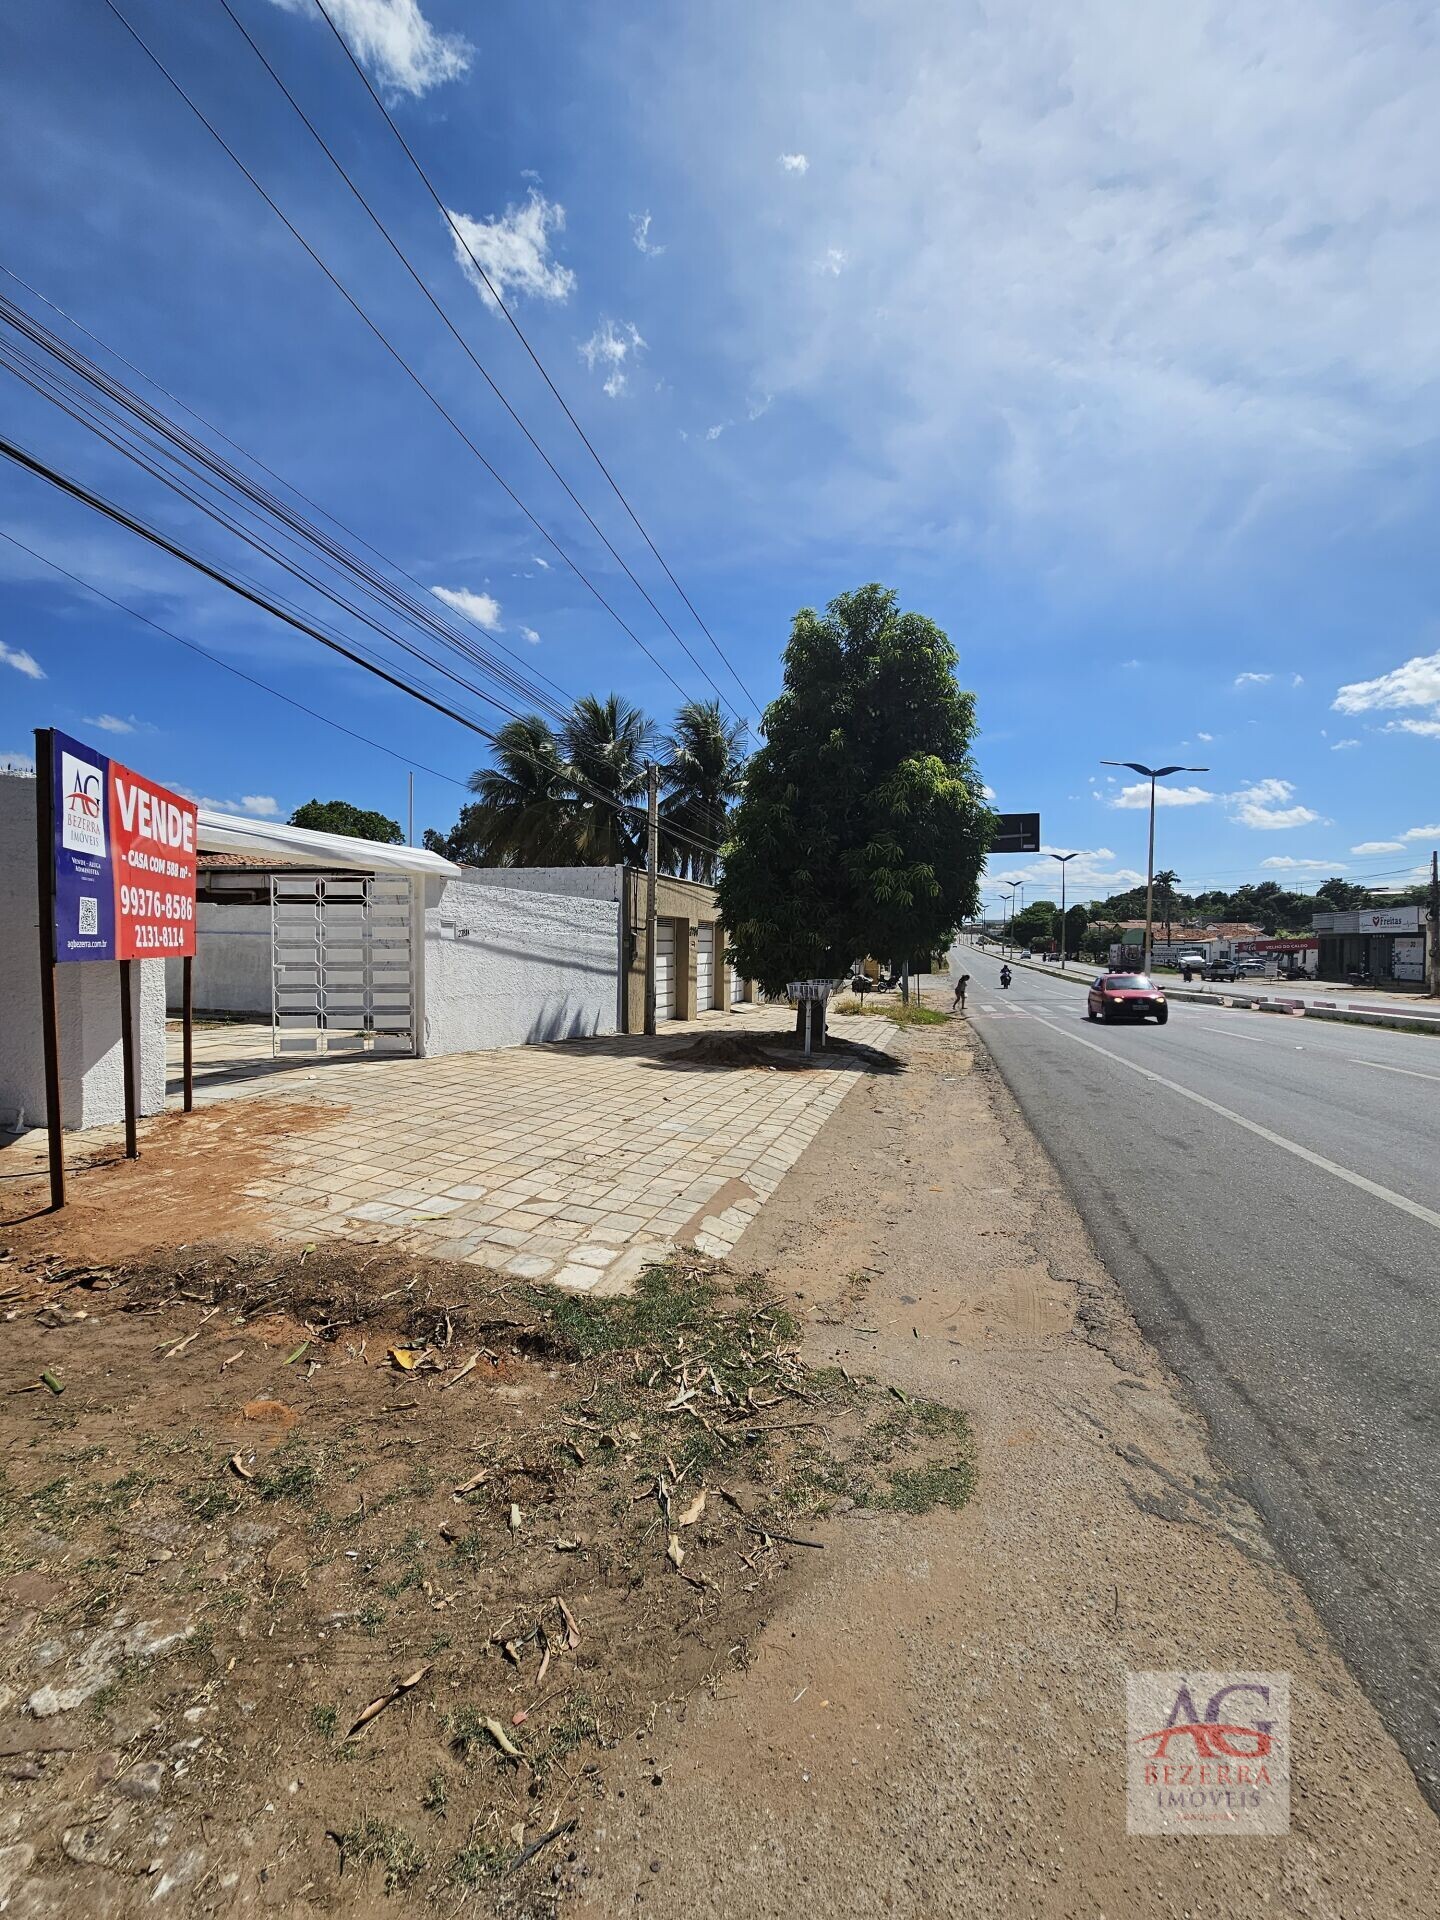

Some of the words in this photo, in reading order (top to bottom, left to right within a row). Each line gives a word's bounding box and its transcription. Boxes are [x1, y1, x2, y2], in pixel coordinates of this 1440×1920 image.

[67, 768, 100, 818] AG
[67, 814, 101, 835] BEZERRA
[115, 777, 193, 853] VENDE
[70, 829, 99, 848] IMÓVEIS
[128, 849, 148, 871] CASA
[149, 856, 165, 874] COM
[166, 861, 178, 878] 588
[120, 884, 193, 921] 99376-8586
[1380, 916, 1402, 925] Freitas
[67, 939, 107, 950] agbezerra.com.br
[135, 925, 184, 948] 2131-8114
